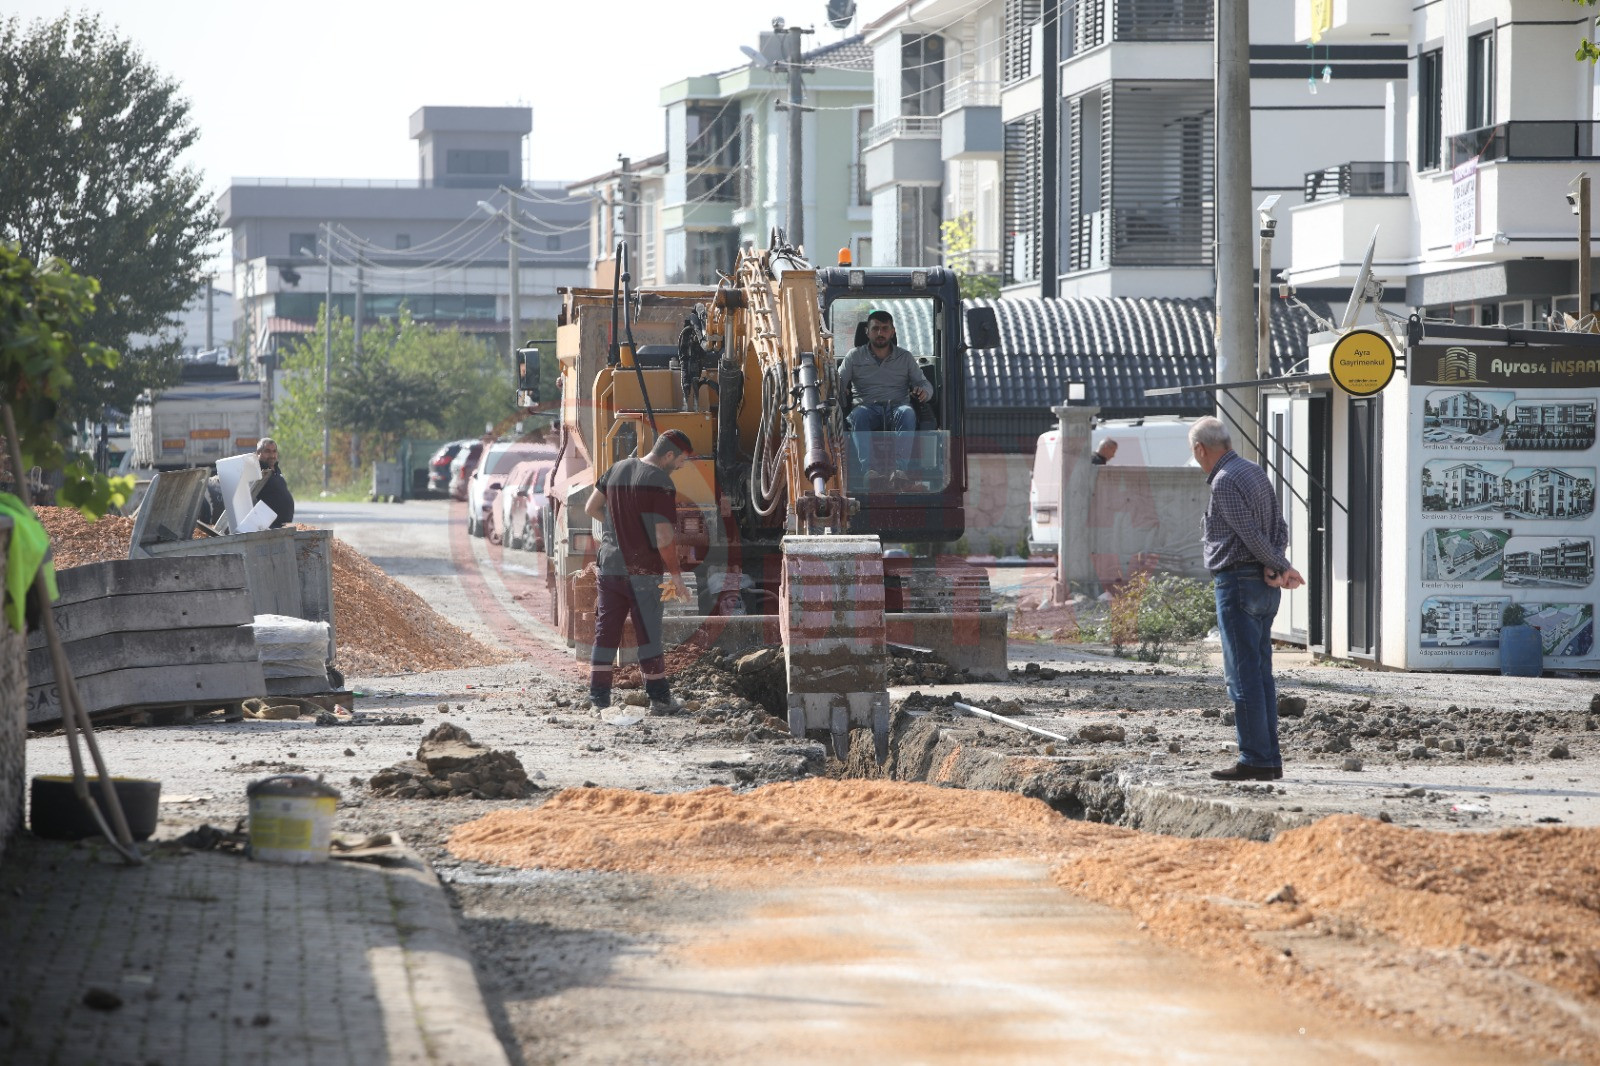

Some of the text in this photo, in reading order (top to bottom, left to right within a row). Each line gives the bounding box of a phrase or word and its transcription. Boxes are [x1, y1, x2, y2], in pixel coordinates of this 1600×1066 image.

[1354, 349, 1370, 357] Ayra
[1340, 359, 1385, 367] Gayrimenkul
[1490, 358, 1547, 377] Ayra54
